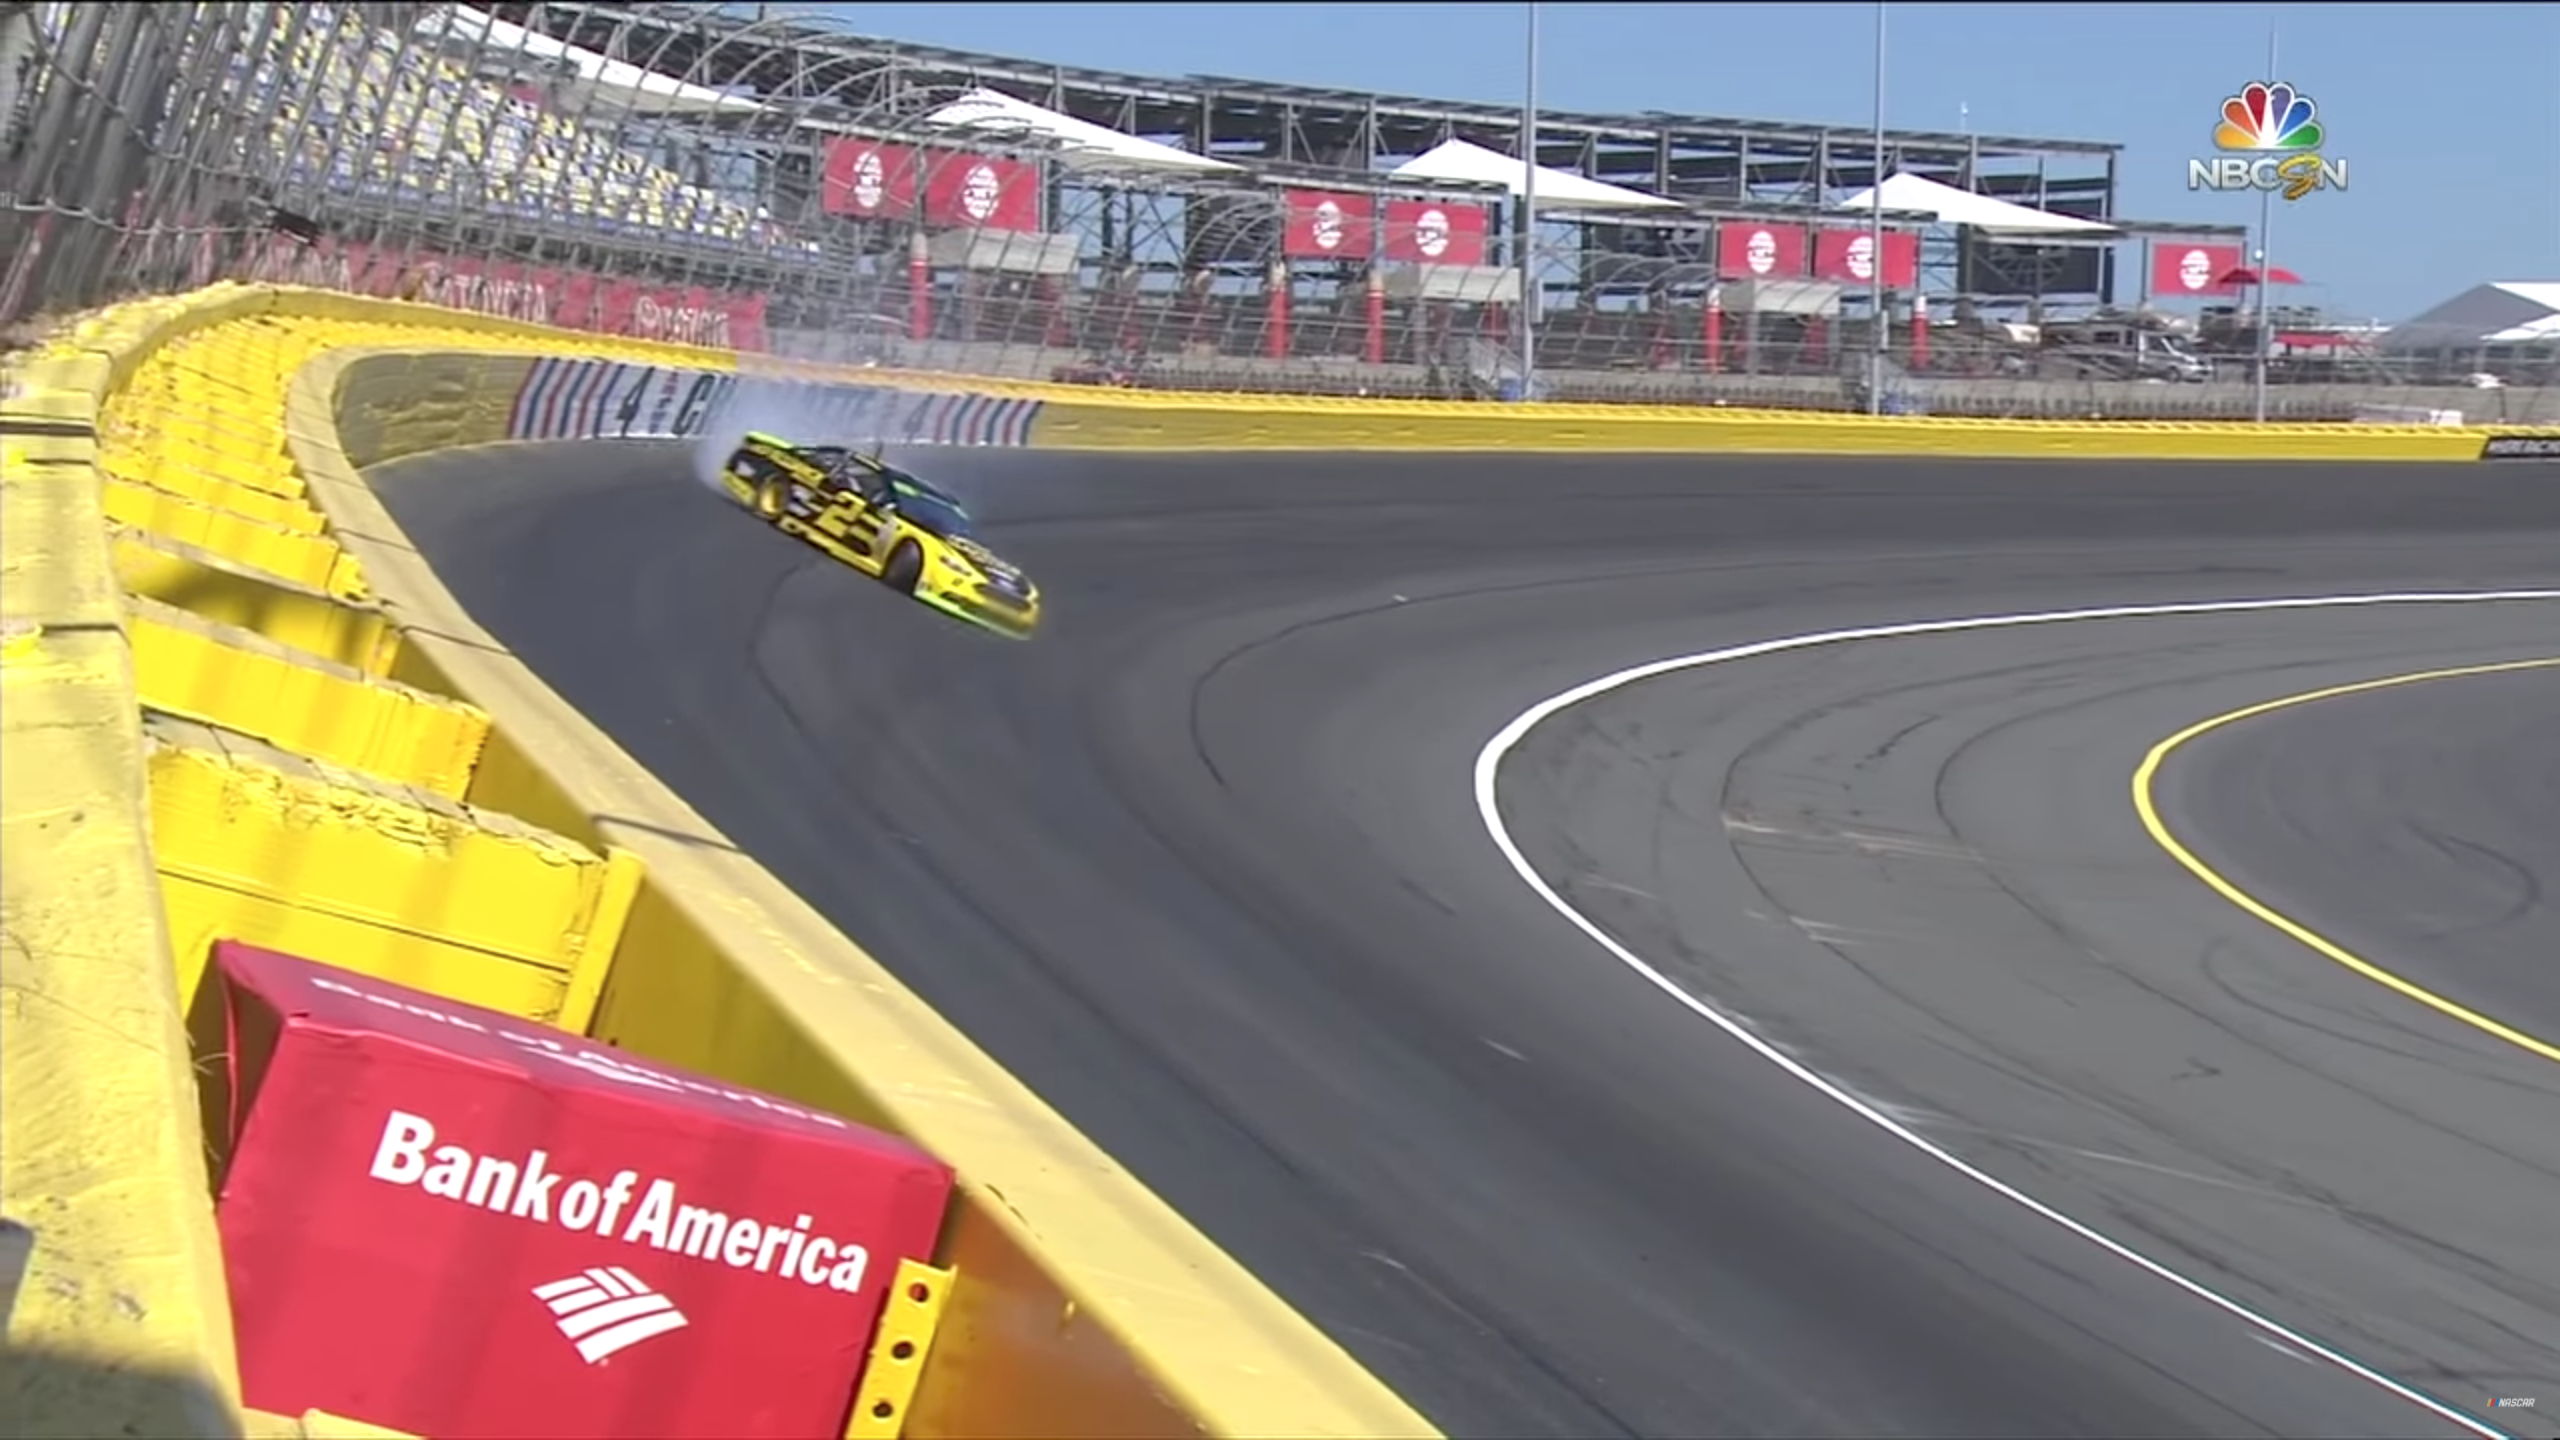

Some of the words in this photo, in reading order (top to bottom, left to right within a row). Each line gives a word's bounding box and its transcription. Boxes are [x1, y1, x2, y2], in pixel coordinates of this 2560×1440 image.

[369, 1110, 561, 1222] Bank
[558, 1170, 638, 1237] of
[622, 1178, 868, 1293] America
